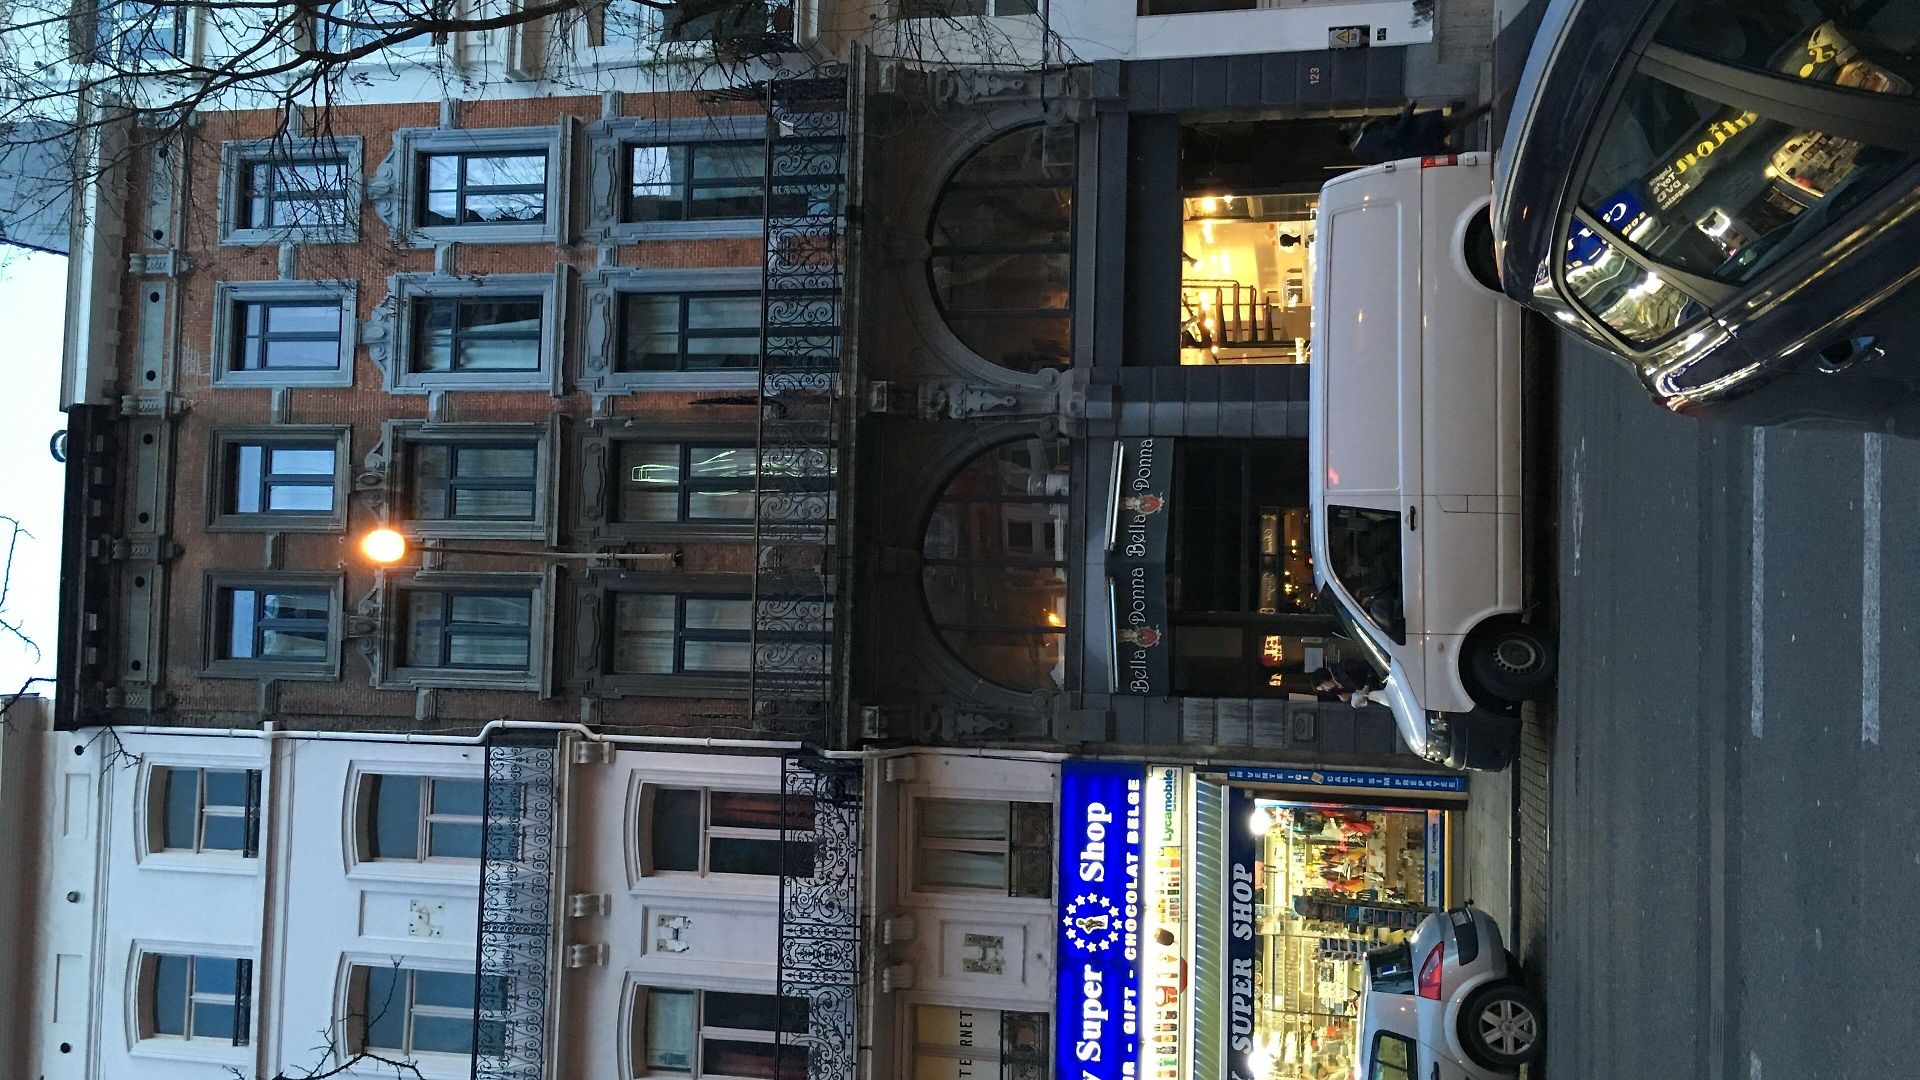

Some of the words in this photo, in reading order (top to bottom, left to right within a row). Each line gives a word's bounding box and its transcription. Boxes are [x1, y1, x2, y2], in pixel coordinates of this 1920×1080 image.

[1310, 67, 1320, 85] 123
[1132, 438, 1153, 491] Donna
[1126, 514, 1148, 556] Bella
[1128, 567, 1147, 625] Donna
[1129, 649, 1150, 693] Bella
[1163, 769, 1174, 841] Lycamobile
[1248, 772, 1283, 780] VENTE
[1326, 776, 1364, 784] CARTE
[1368, 777, 1390, 786] SIM
[1126, 778, 1140, 844] BELGE
[1079, 802, 1112, 882] Shop
[1124, 852, 1139, 960] CHOCOLAT
[1232, 862, 1253, 940] SHOP
[1075, 964, 1109, 1062] Super
[1123, 986, 1136, 1034] GIFT
[1232, 958, 1252, 1054] SUPER
